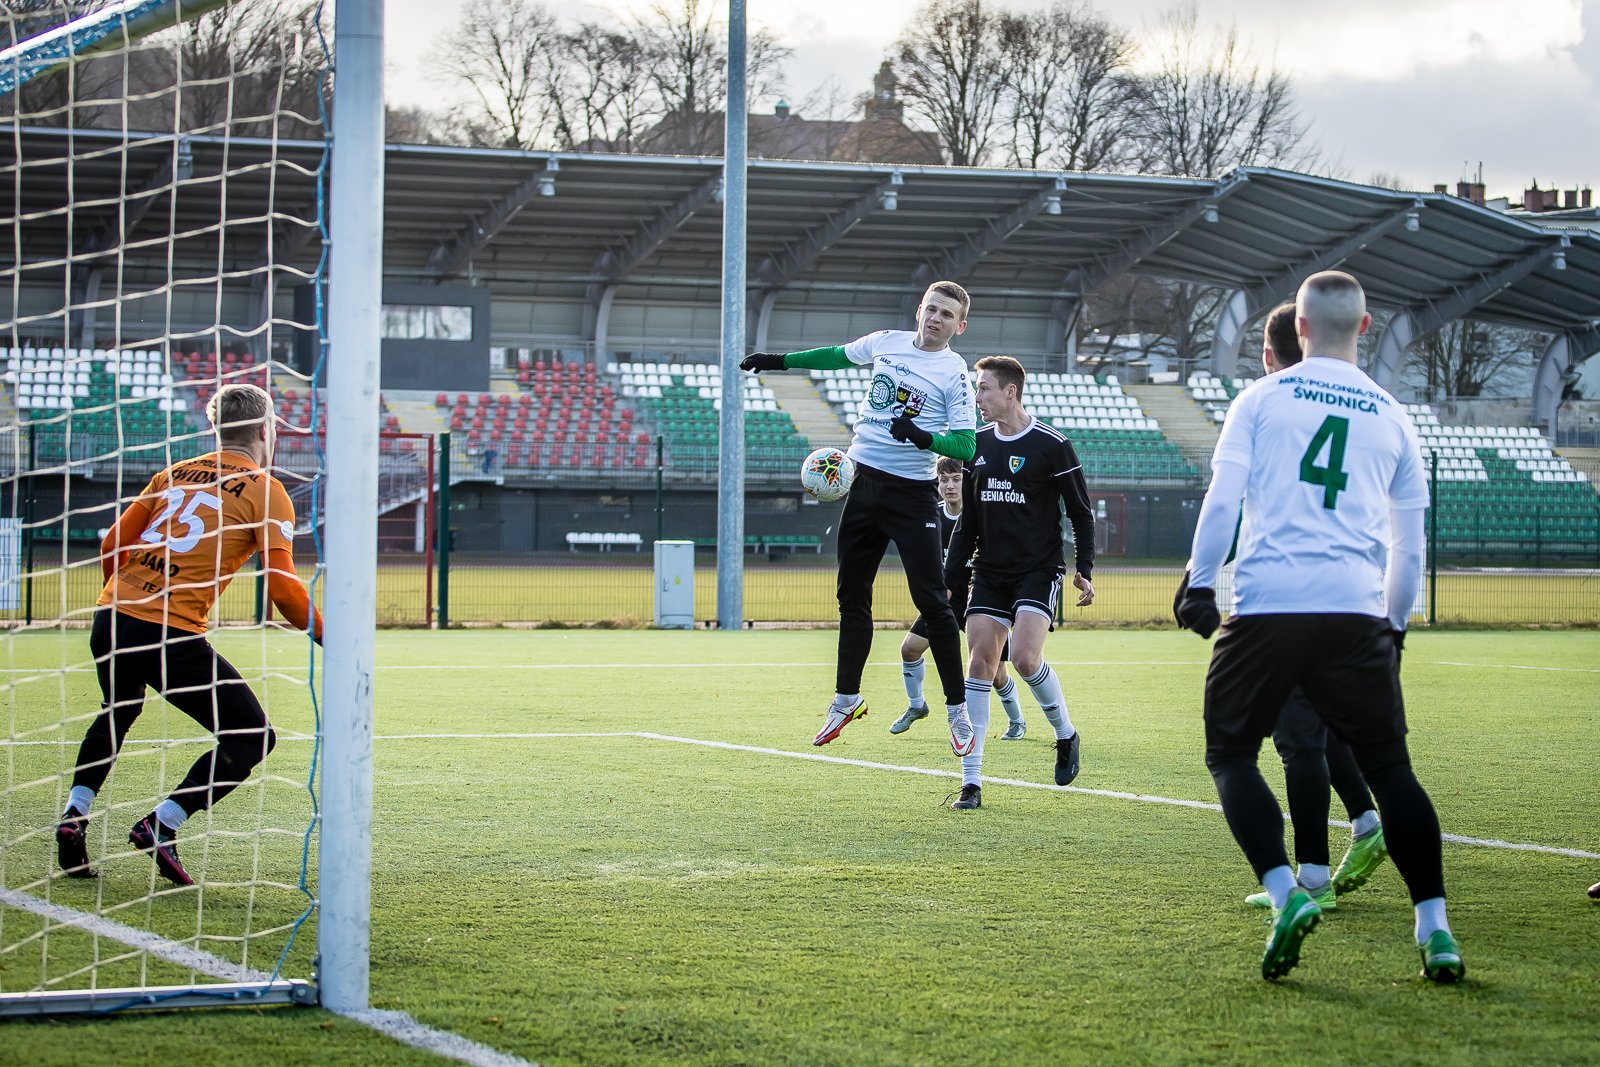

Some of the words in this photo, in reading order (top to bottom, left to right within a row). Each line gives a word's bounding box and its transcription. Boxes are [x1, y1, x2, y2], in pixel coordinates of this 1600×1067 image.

[1294, 386, 1379, 415] ŚWIDNICA
[1299, 414, 1350, 510] 4
[171, 466, 247, 499] ŚWIDNCA
[987, 477, 1012, 490] Miasto
[1005, 489, 1026, 504] GÓRA
[141, 487, 224, 553] 25
